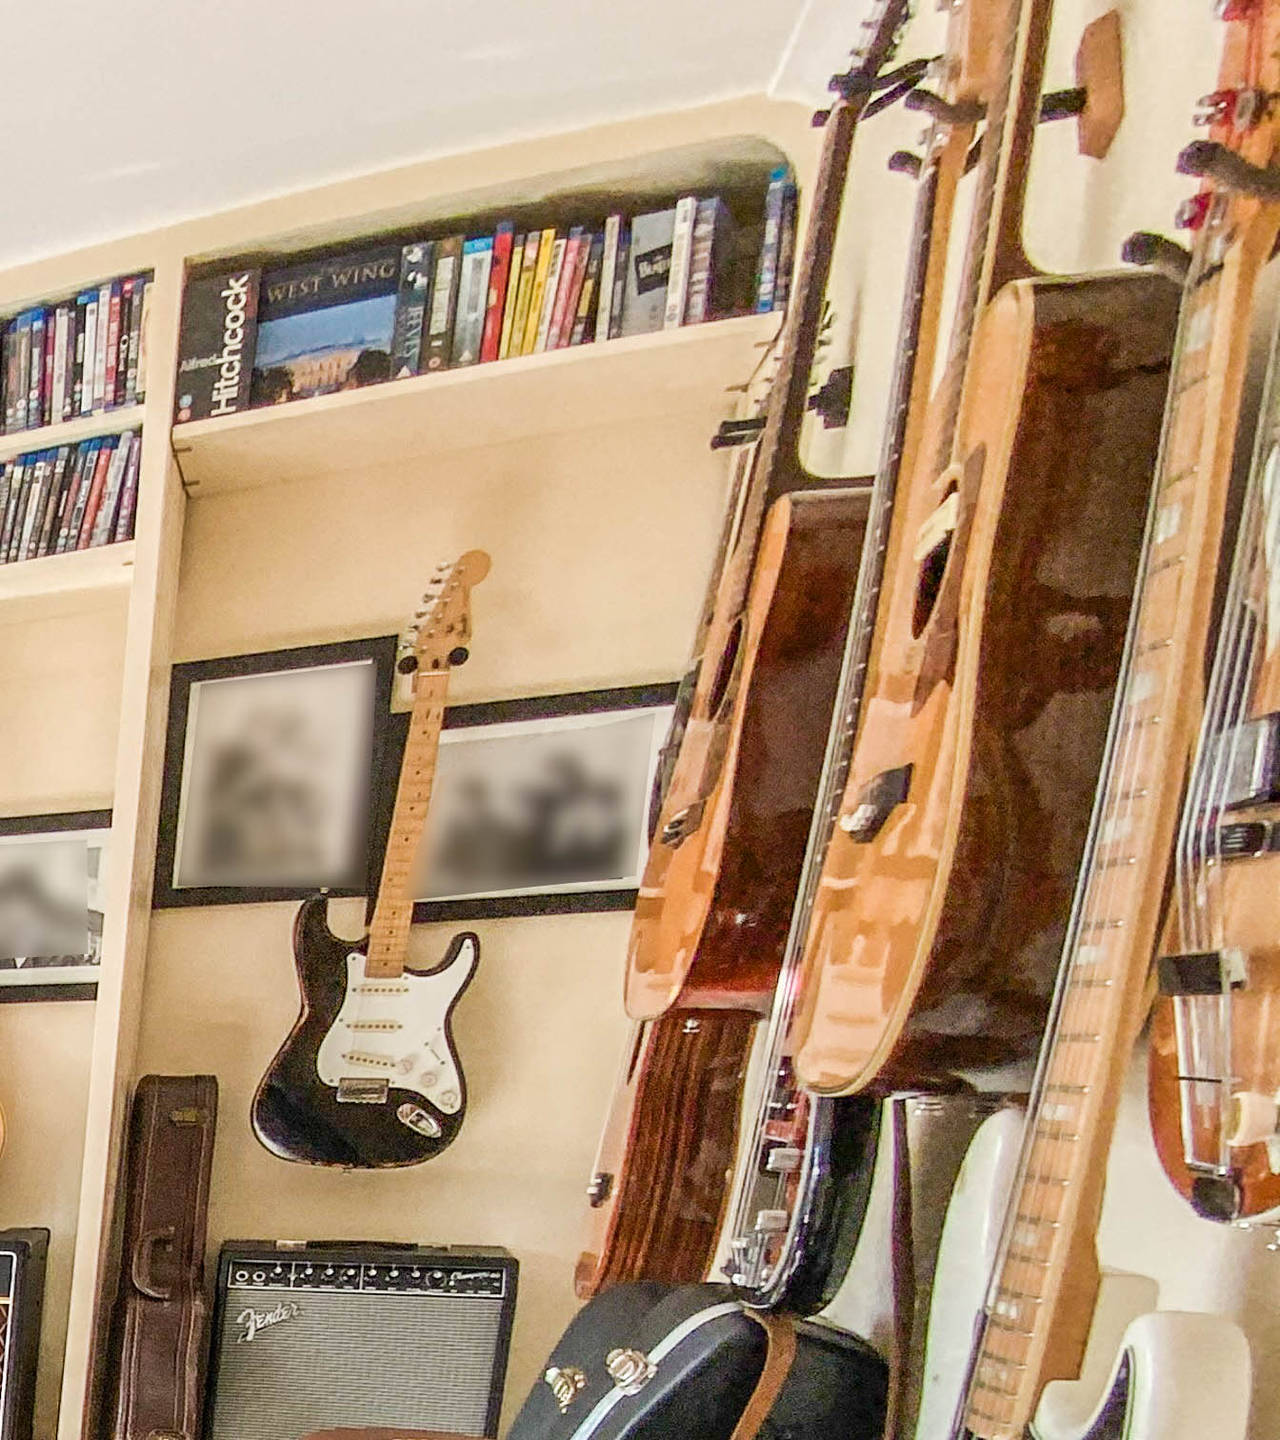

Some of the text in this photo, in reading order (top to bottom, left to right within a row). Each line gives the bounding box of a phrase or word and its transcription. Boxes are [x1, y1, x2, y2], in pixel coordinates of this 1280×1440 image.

[268, 260, 395, 303] WEST WING
[179, 354, 218, 372] Alfred
[210, 273, 249, 417] Hitchcock
[236, 1302, 301, 1343] Fender
